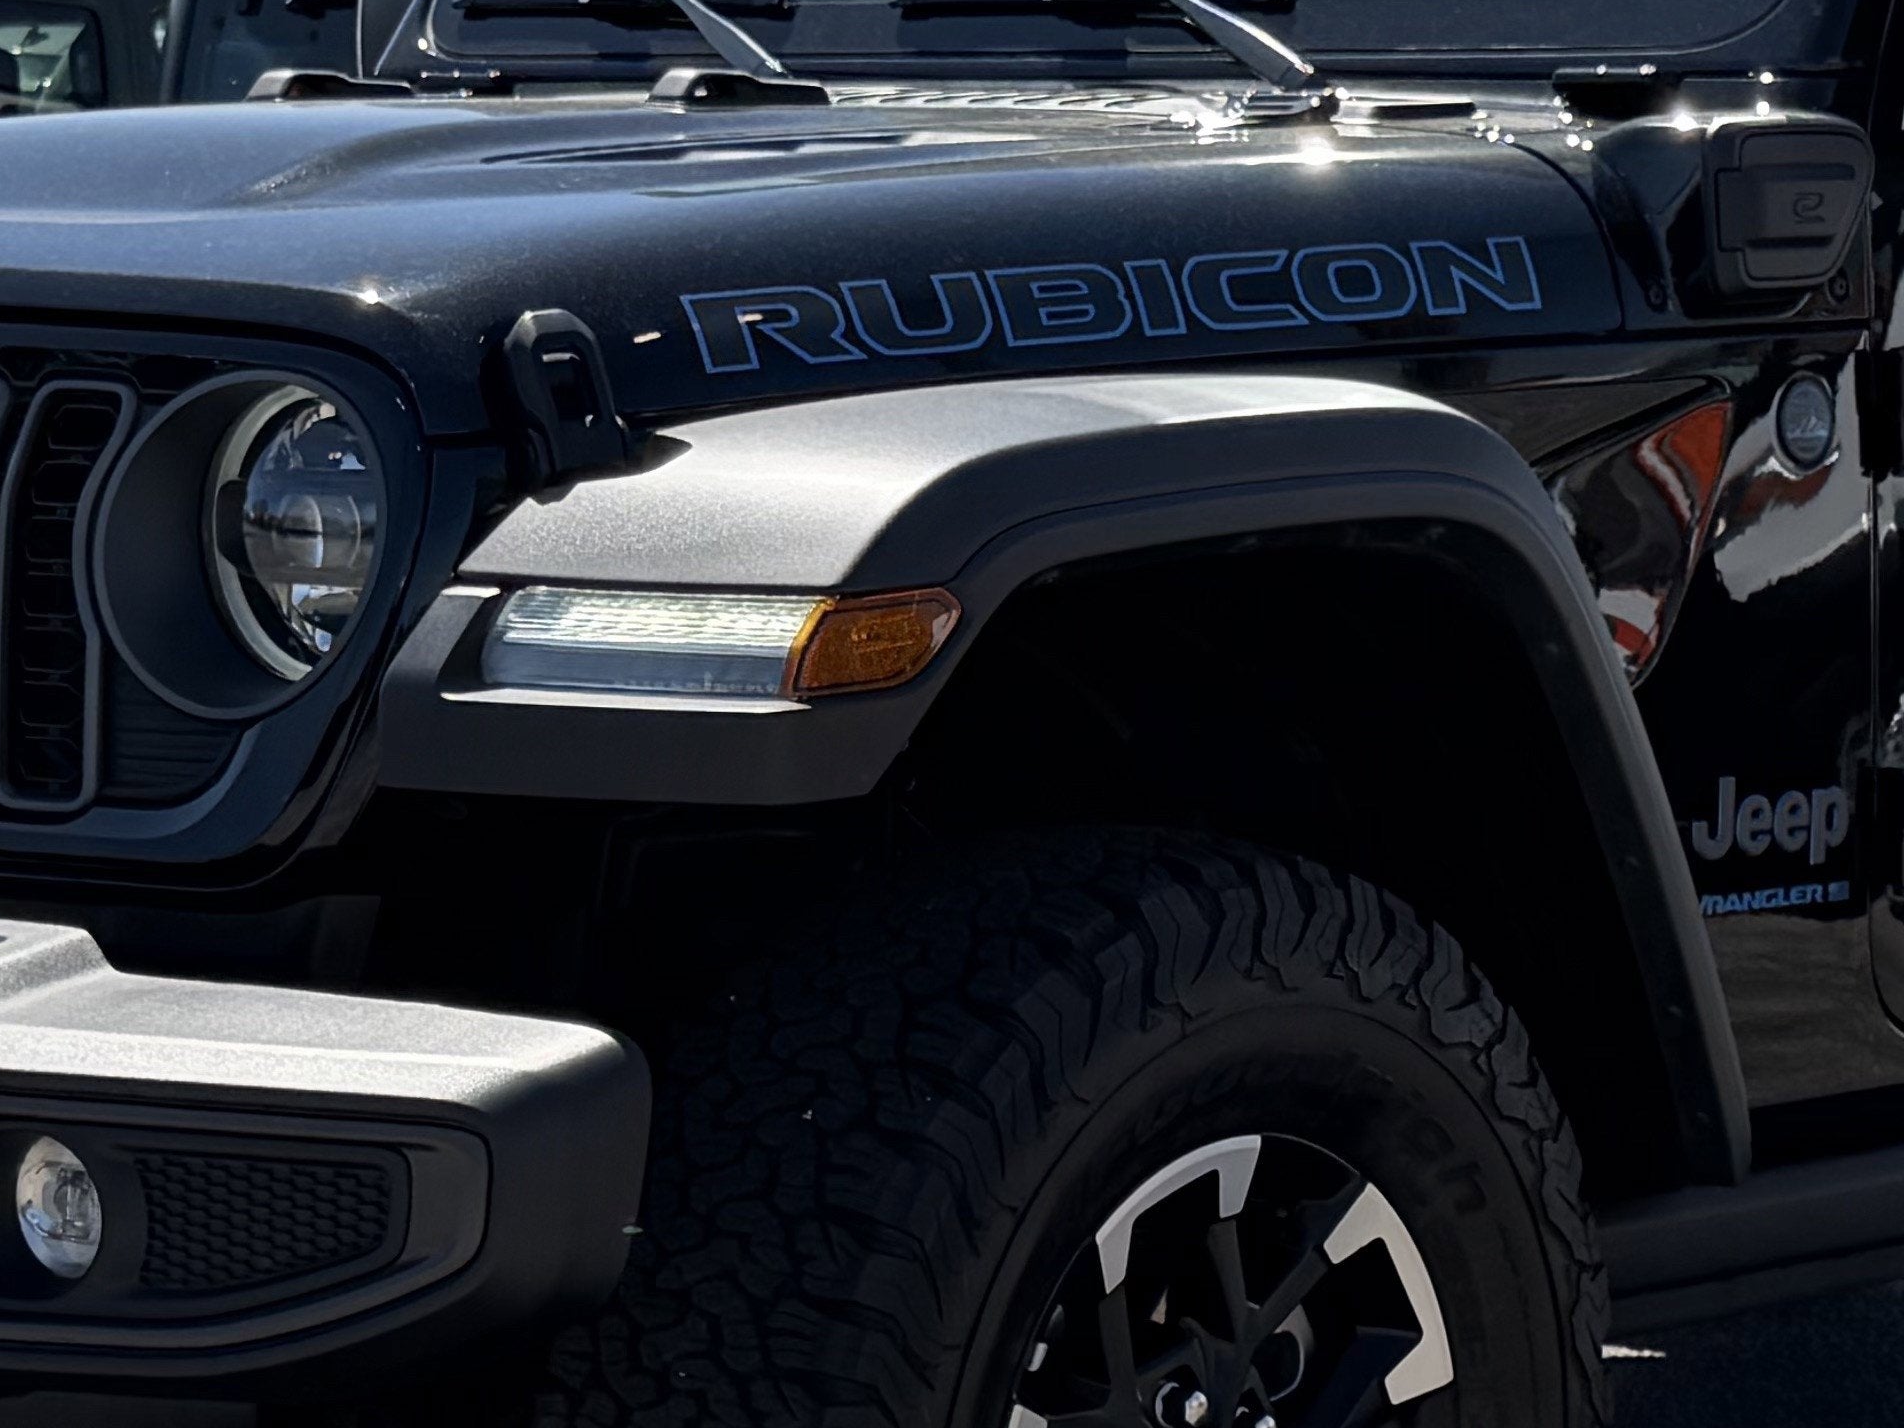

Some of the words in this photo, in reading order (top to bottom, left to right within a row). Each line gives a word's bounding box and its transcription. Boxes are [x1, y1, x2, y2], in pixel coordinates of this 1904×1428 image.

[679, 237, 1542, 373] RUBICON
[1692, 776, 1850, 866] Jeep
[1700, 884, 1824, 916] RANGLER
